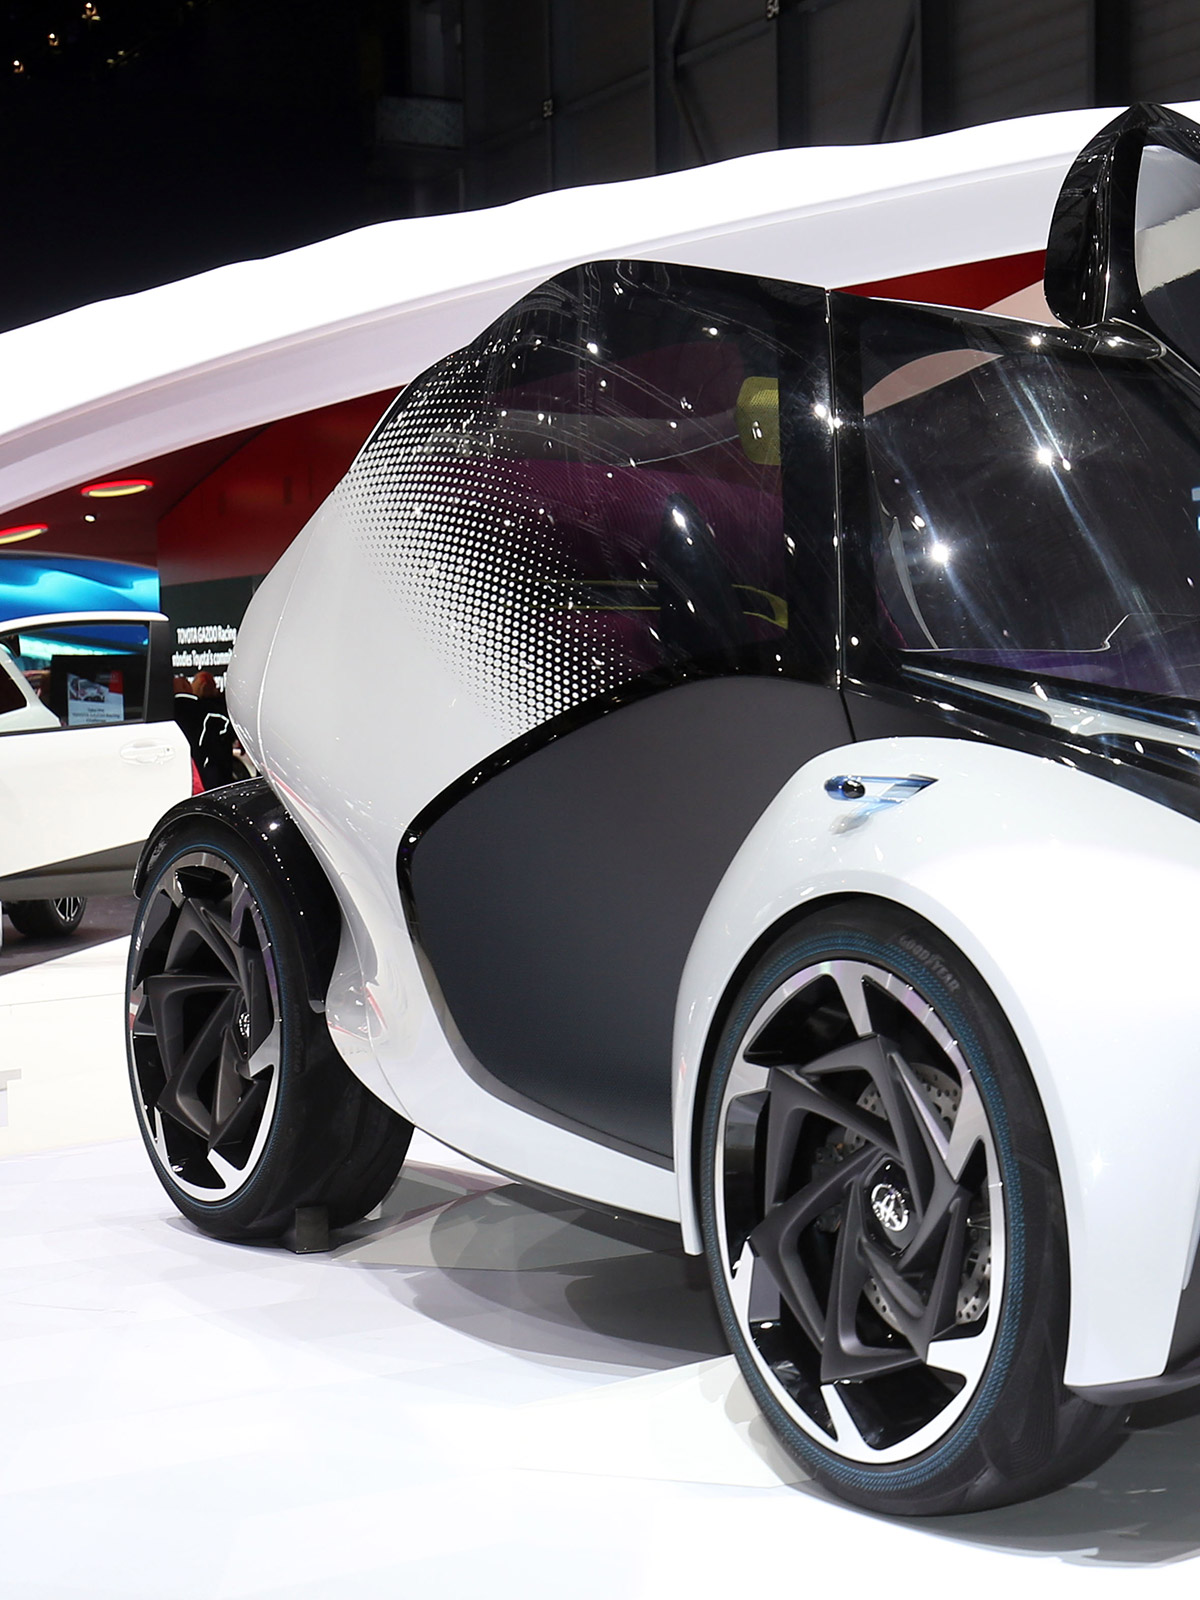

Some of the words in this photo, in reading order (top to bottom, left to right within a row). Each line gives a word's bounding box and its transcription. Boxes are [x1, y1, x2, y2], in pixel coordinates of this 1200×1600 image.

[176, 627, 197, 645] TOYOTA
[198, 625, 217, 643] GAZOO
[217, 624, 237, 645] Racing
[192, 649, 213, 670] Toyota's
[899, 934, 961, 993] GOODYEAR
